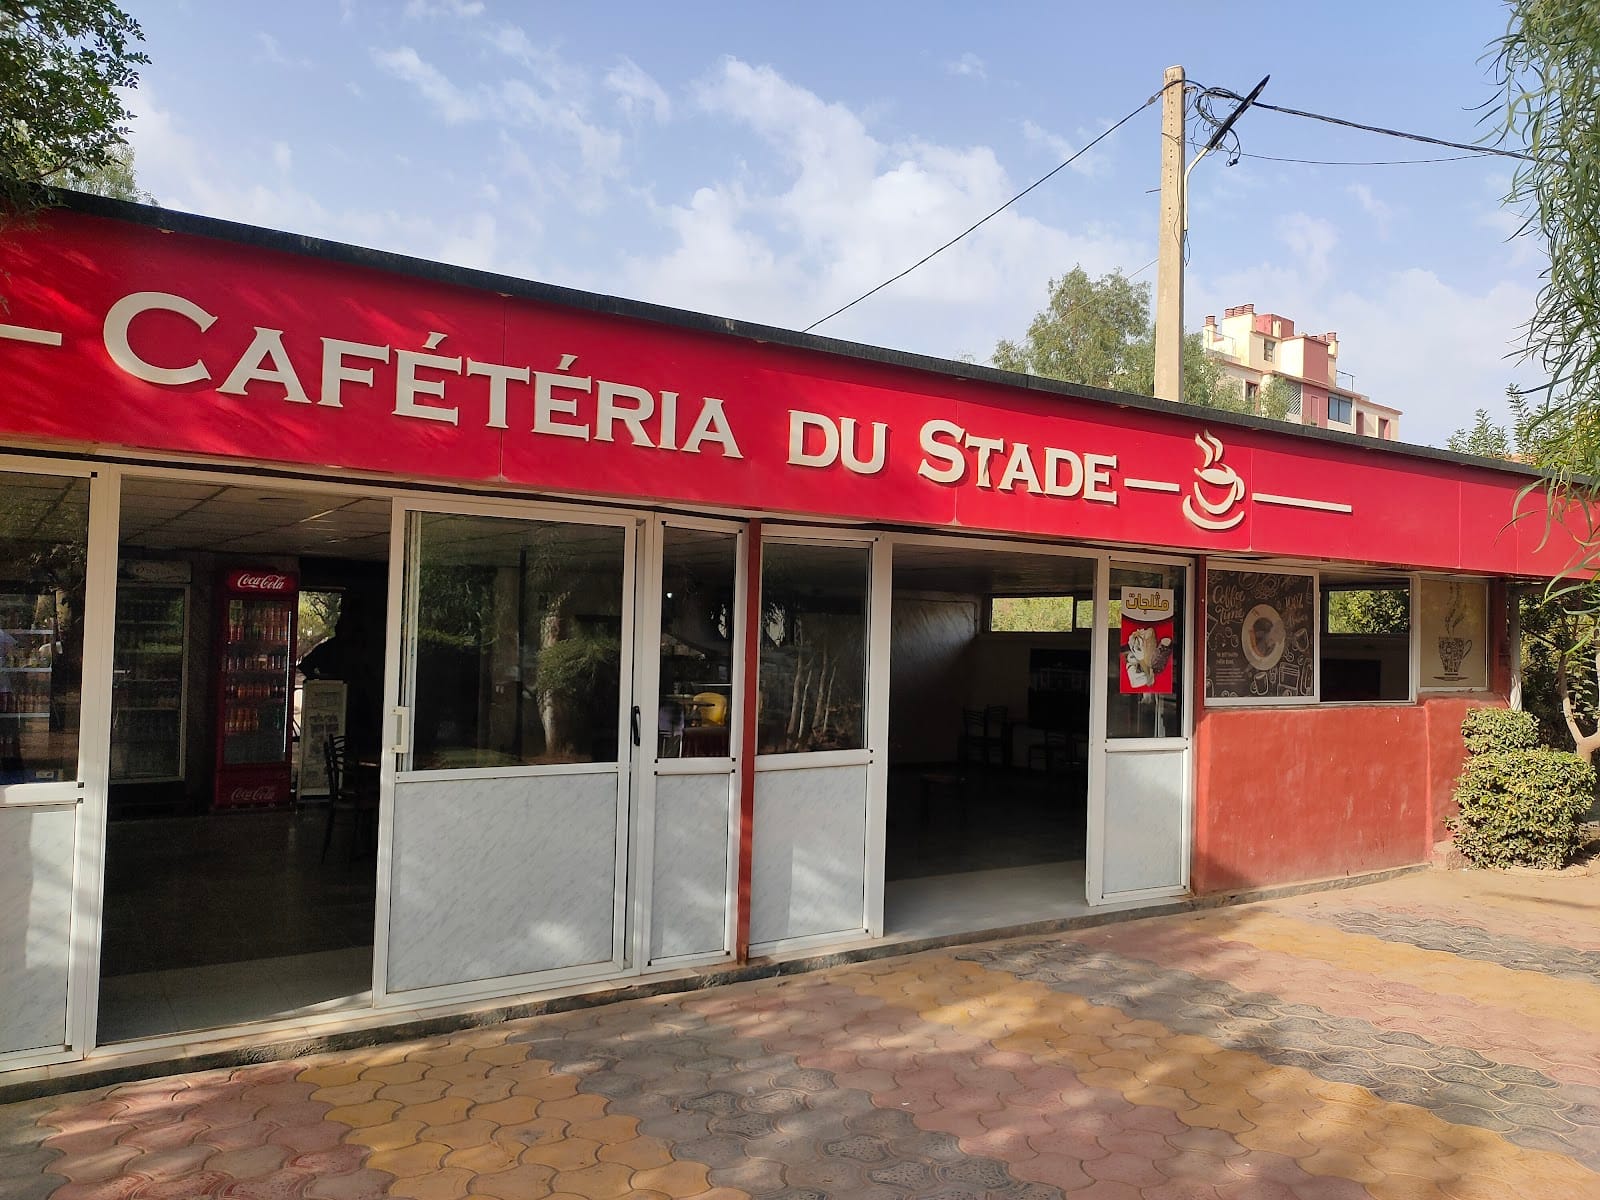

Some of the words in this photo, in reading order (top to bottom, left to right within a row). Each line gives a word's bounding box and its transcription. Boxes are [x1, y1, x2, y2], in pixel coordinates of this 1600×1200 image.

[103, 291, 744, 459] CAFÉTÉRIA
[786, 409, 889, 475] DU
[917, 419, 1118, 505] STADE
[237, 573, 286, 590] Coca-Cola
[1125, 591, 1170, 615] مثلجات
[1212, 585, 1246, 608] Coffee
[1214, 604, 1245, 625] Time
